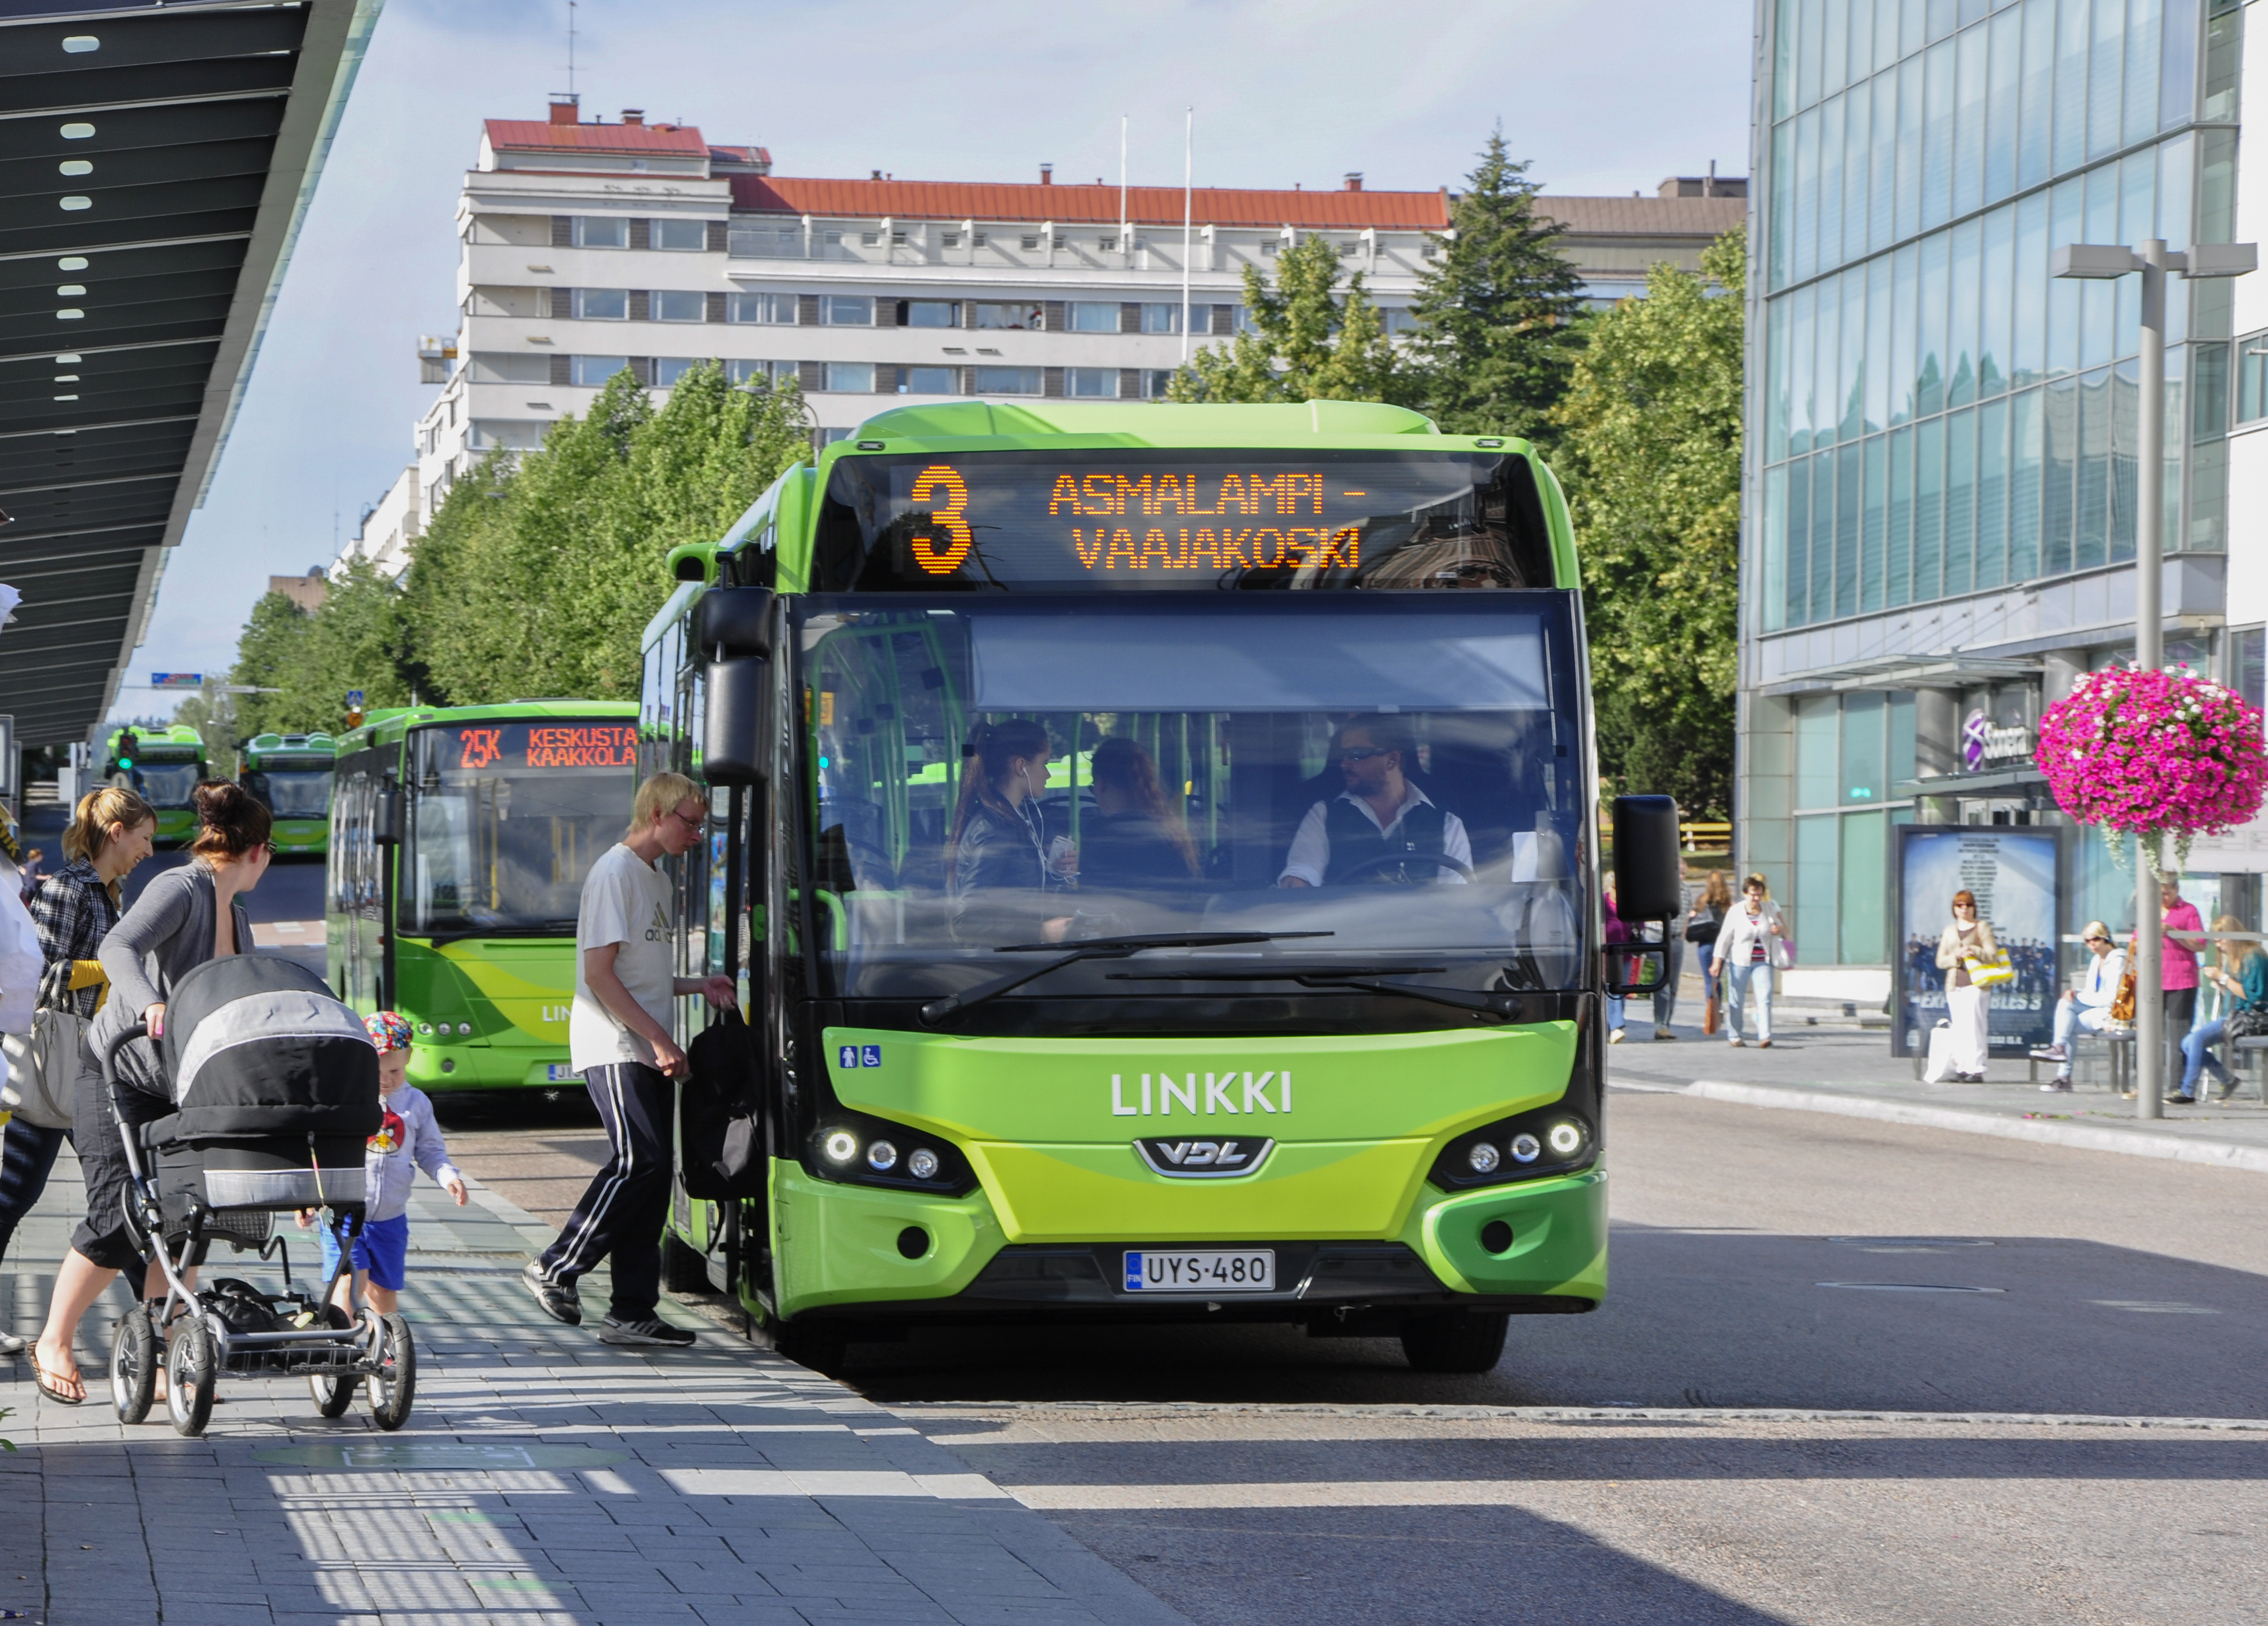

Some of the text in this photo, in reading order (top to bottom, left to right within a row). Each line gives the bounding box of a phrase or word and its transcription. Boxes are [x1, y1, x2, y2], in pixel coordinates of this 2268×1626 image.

[1048, 473, 1324, 515] ASMALAMPI
[911, 465, 971, 575] 3
[1072, 528, 1361, 569] VAAJAKOSKI
[460, 729, 502, 768] 25K
[529, 727, 638, 748] KESKUSTA
[526, 746, 637, 767] KAAKKOLA
[1111, 1070, 1292, 1116] LINKKI
[1155, 1141, 1248, 1165] VDL
[1127, 1274, 1141, 1282] FIN
[1148, 1257, 1265, 1283] UYS-480
